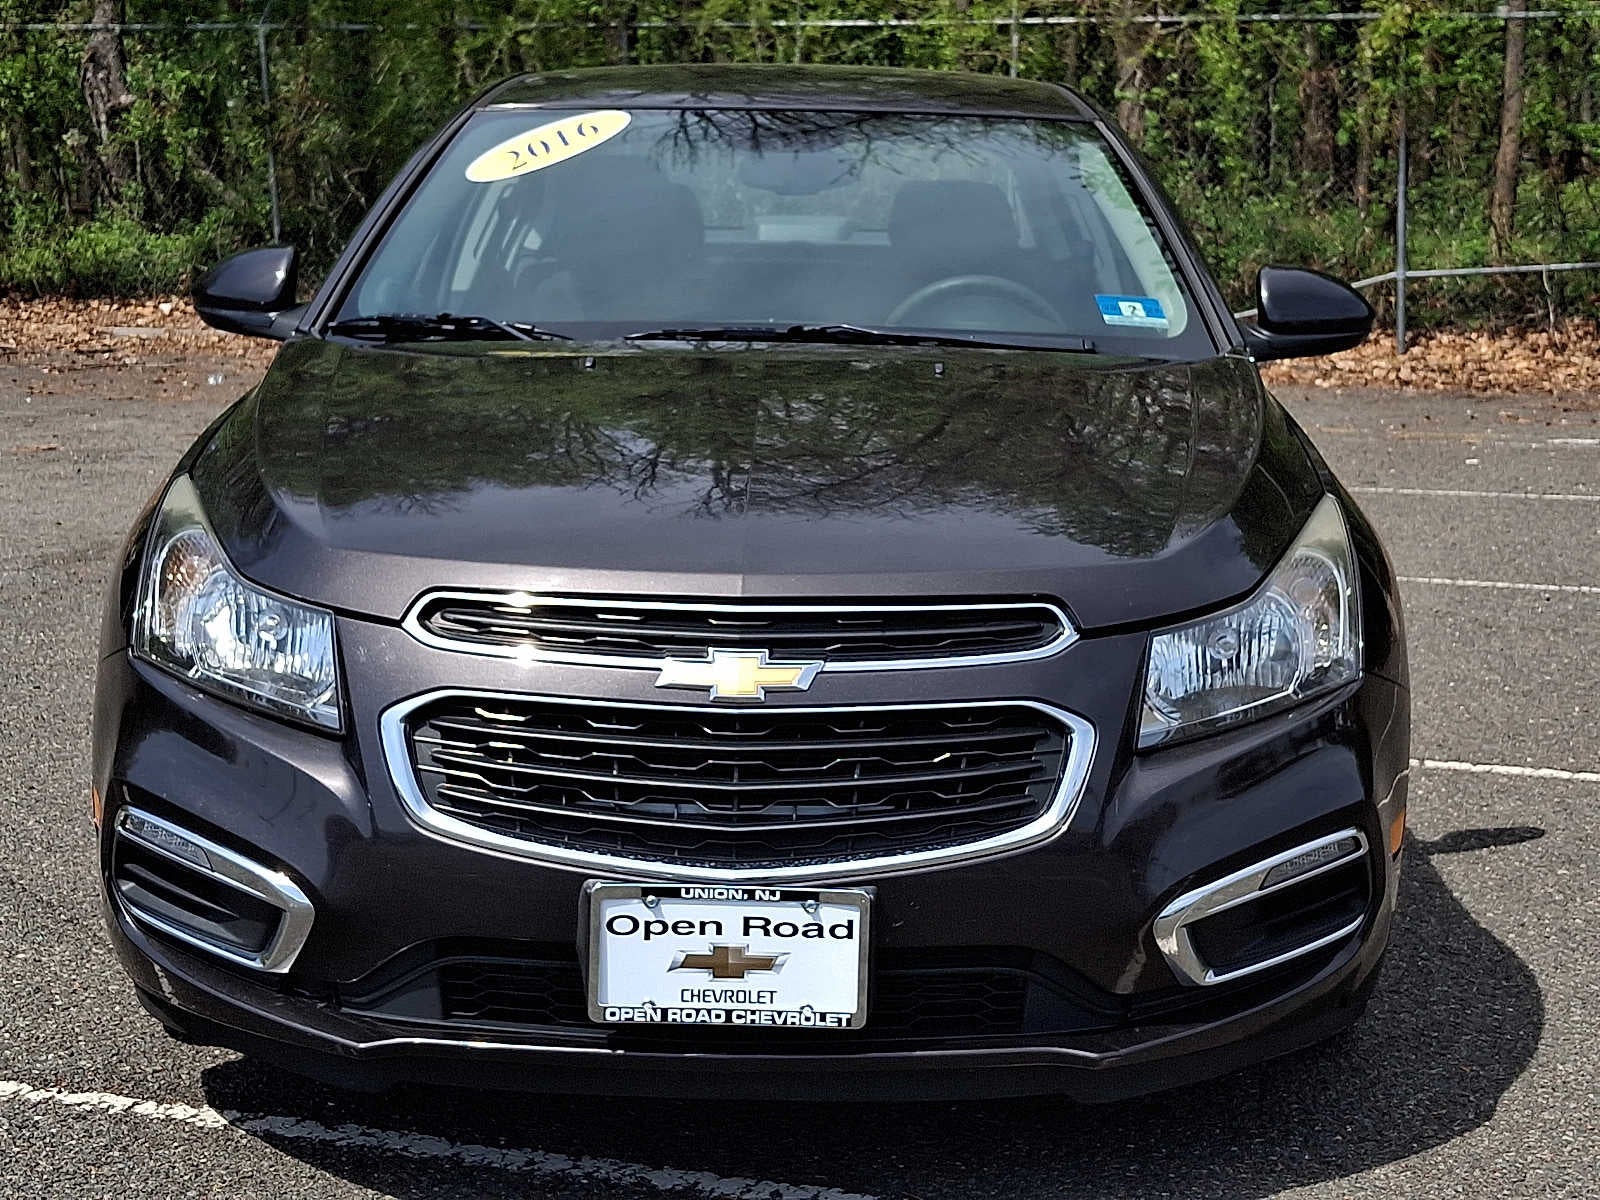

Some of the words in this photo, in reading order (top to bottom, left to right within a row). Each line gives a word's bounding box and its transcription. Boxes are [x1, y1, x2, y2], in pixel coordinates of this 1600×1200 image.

[507, 123, 598, 170] 2016
[681, 887, 748, 900] UNION,
[754, 888, 781, 901] NJ
[606, 914, 723, 940] Open
[743, 916, 854, 940] Road
[680, 988, 777, 1004] CHEVROLET
[605, 1007, 661, 1022] OPEN
[668, 1009, 725, 1024] ROAD
[731, 1010, 850, 1027] CHEVROLET
